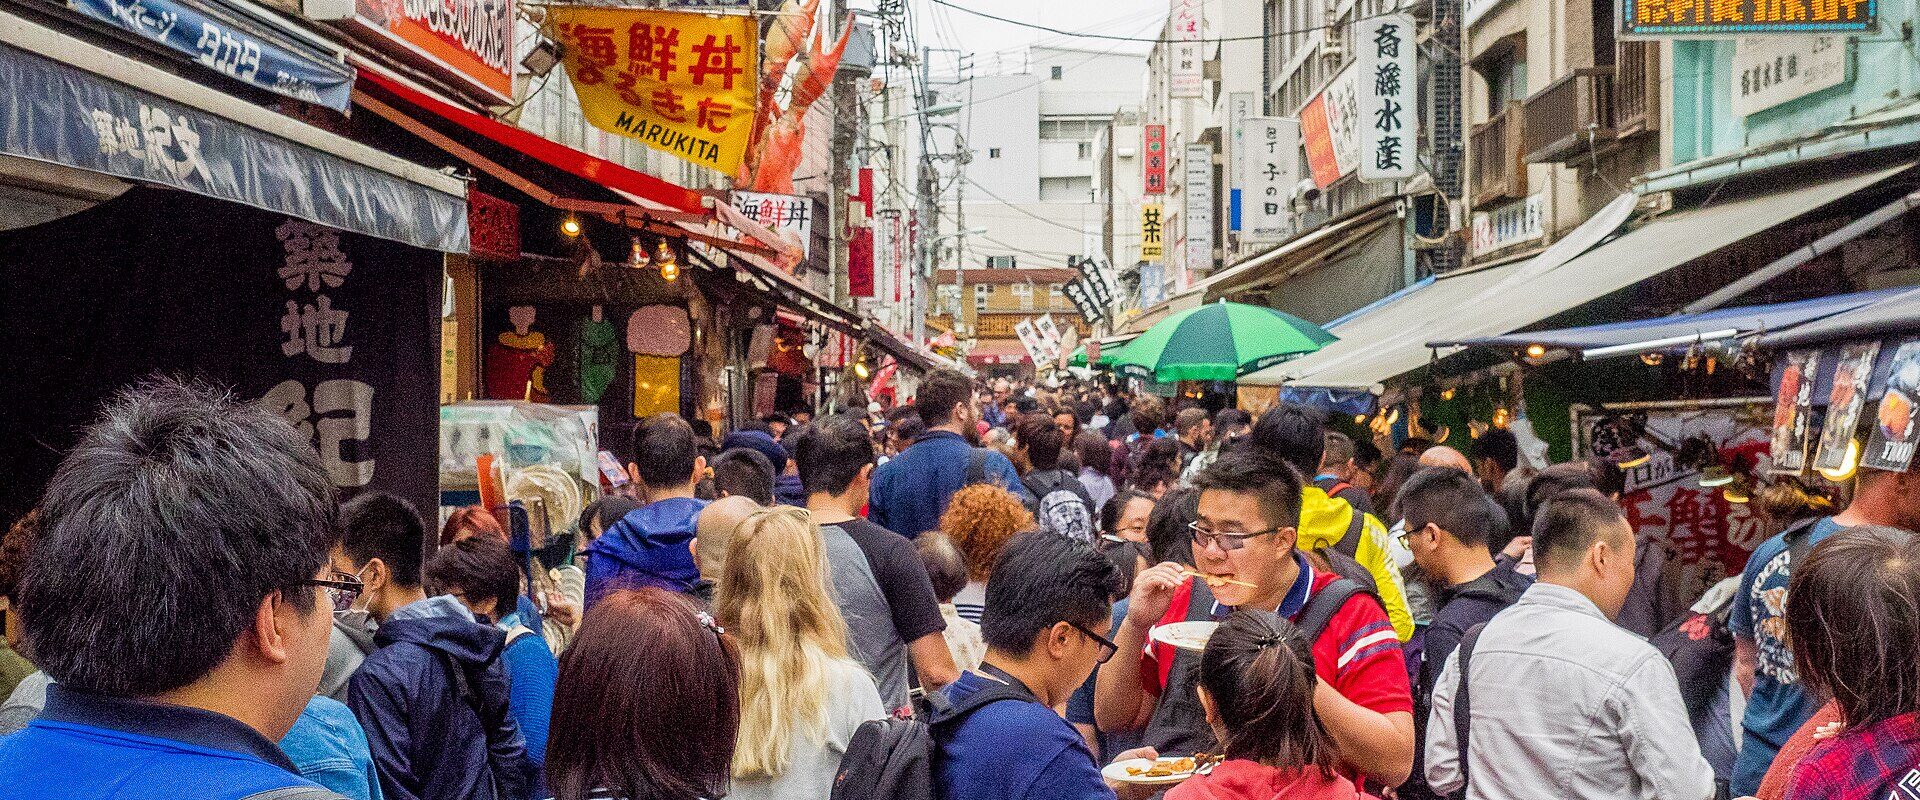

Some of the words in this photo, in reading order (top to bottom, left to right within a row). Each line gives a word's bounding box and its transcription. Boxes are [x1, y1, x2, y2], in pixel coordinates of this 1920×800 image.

[559, 22, 743, 90] 海鮮丼
[614, 111, 720, 163] MARUKITA
[734, 195, 810, 231] 海鮮丼
[1143, 208, 1161, 243] 茶
